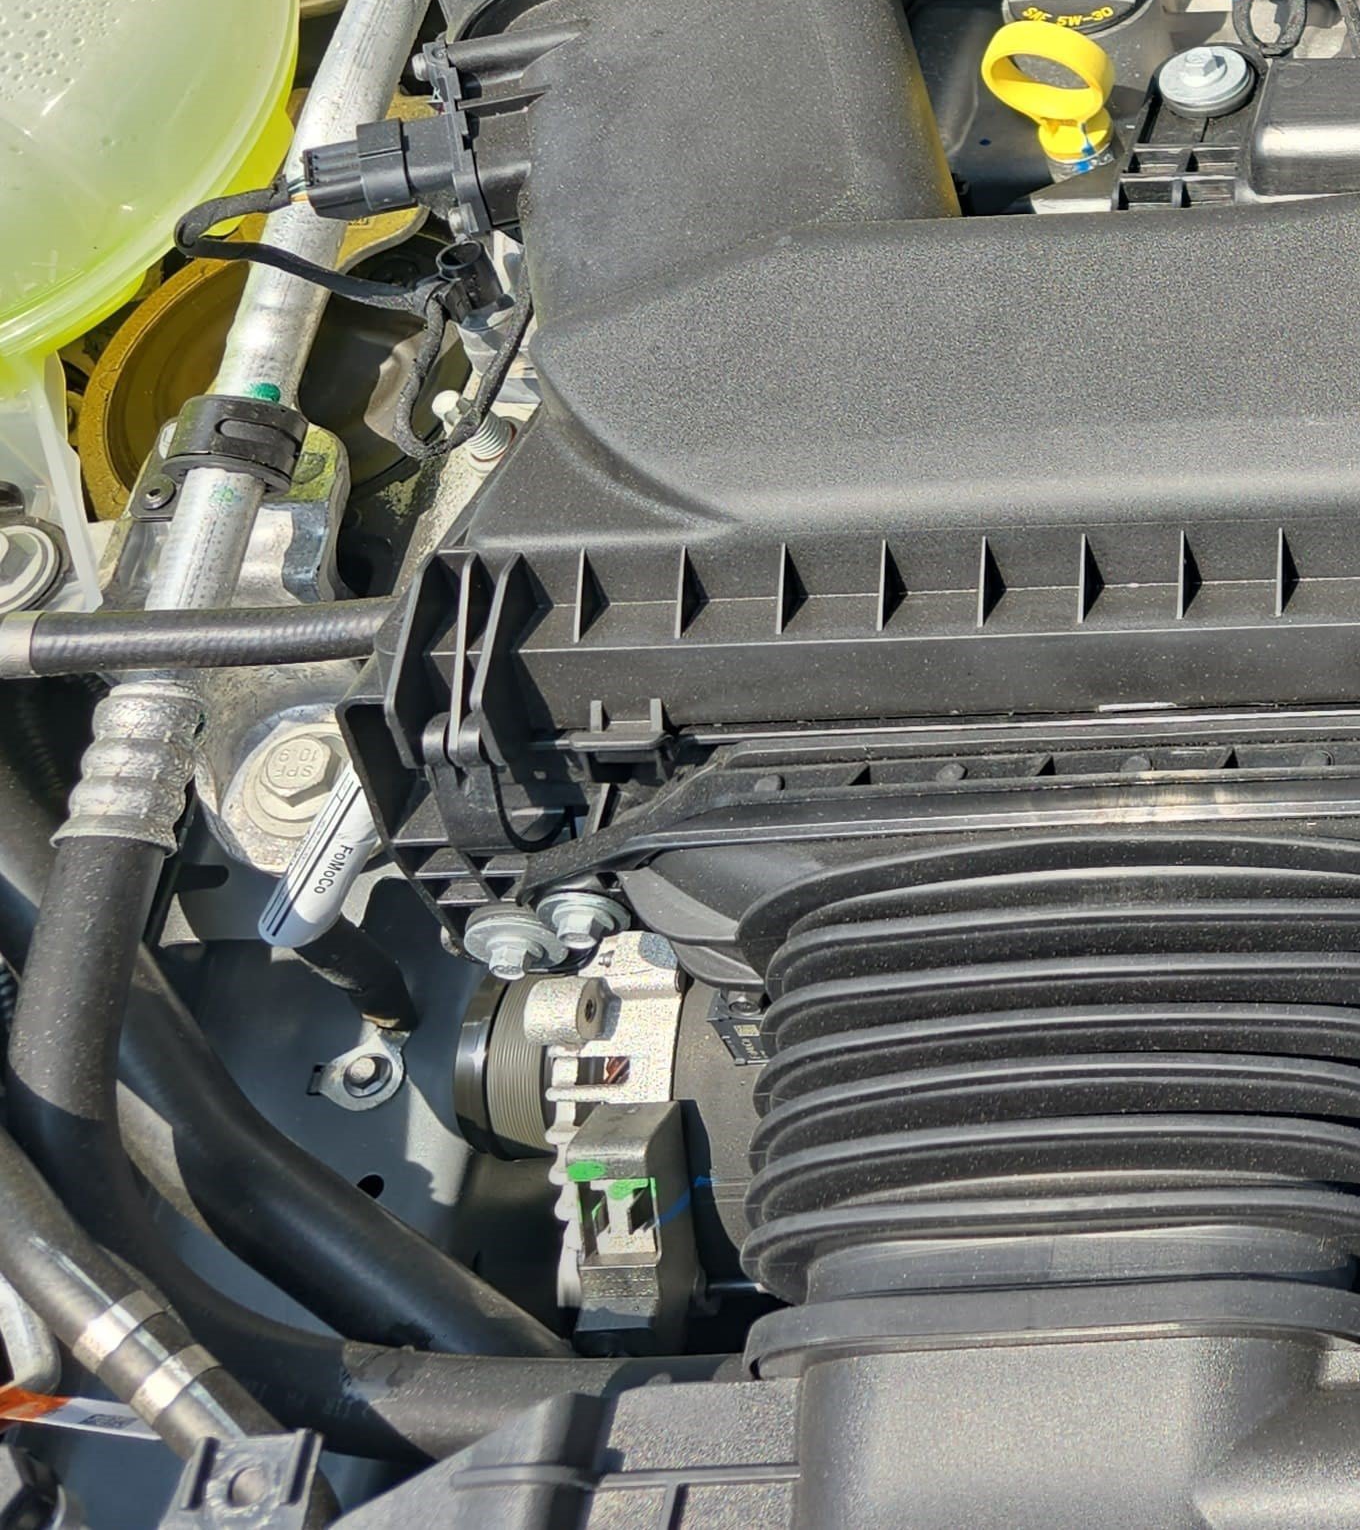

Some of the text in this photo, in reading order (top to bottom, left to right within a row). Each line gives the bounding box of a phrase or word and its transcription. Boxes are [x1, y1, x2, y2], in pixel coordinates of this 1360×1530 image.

[1022, 6, 1114, 26] SAE 5W-30
[278, 748, 318, 763] 10.9
[273, 766, 314, 778] SPF
[313, 844, 354, 894] FoMoCo
